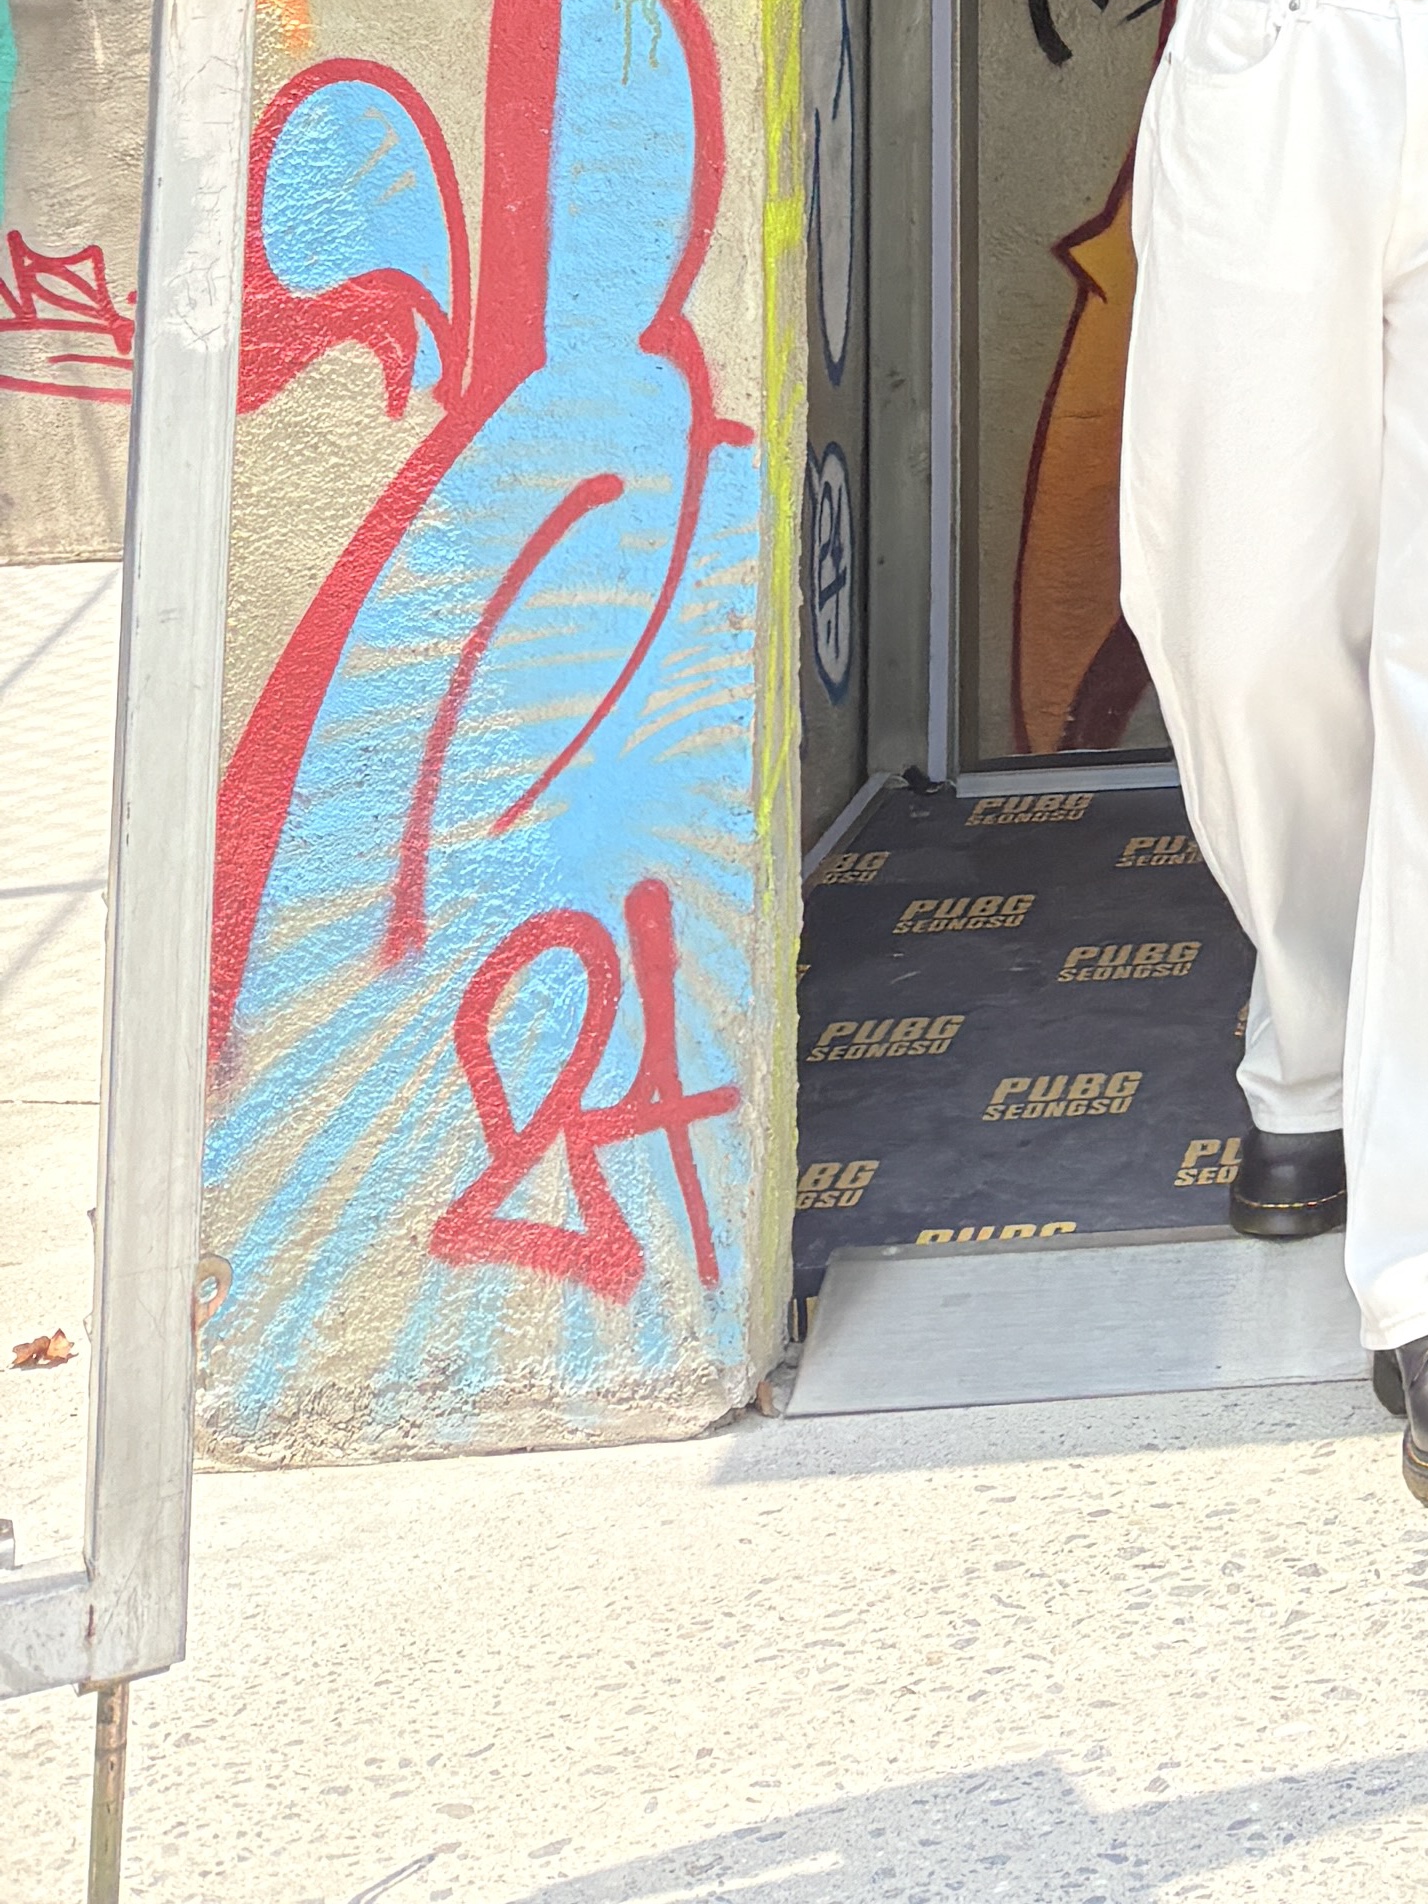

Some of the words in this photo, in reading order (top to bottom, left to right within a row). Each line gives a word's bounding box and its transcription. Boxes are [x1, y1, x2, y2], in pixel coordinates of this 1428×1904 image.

[901, 893, 1036, 922] PUBG
[1064, 940, 1202, 969] PUBG
[816, 1014, 966, 1046] PUBG
[991, 1070, 1144, 1105] PUBG
